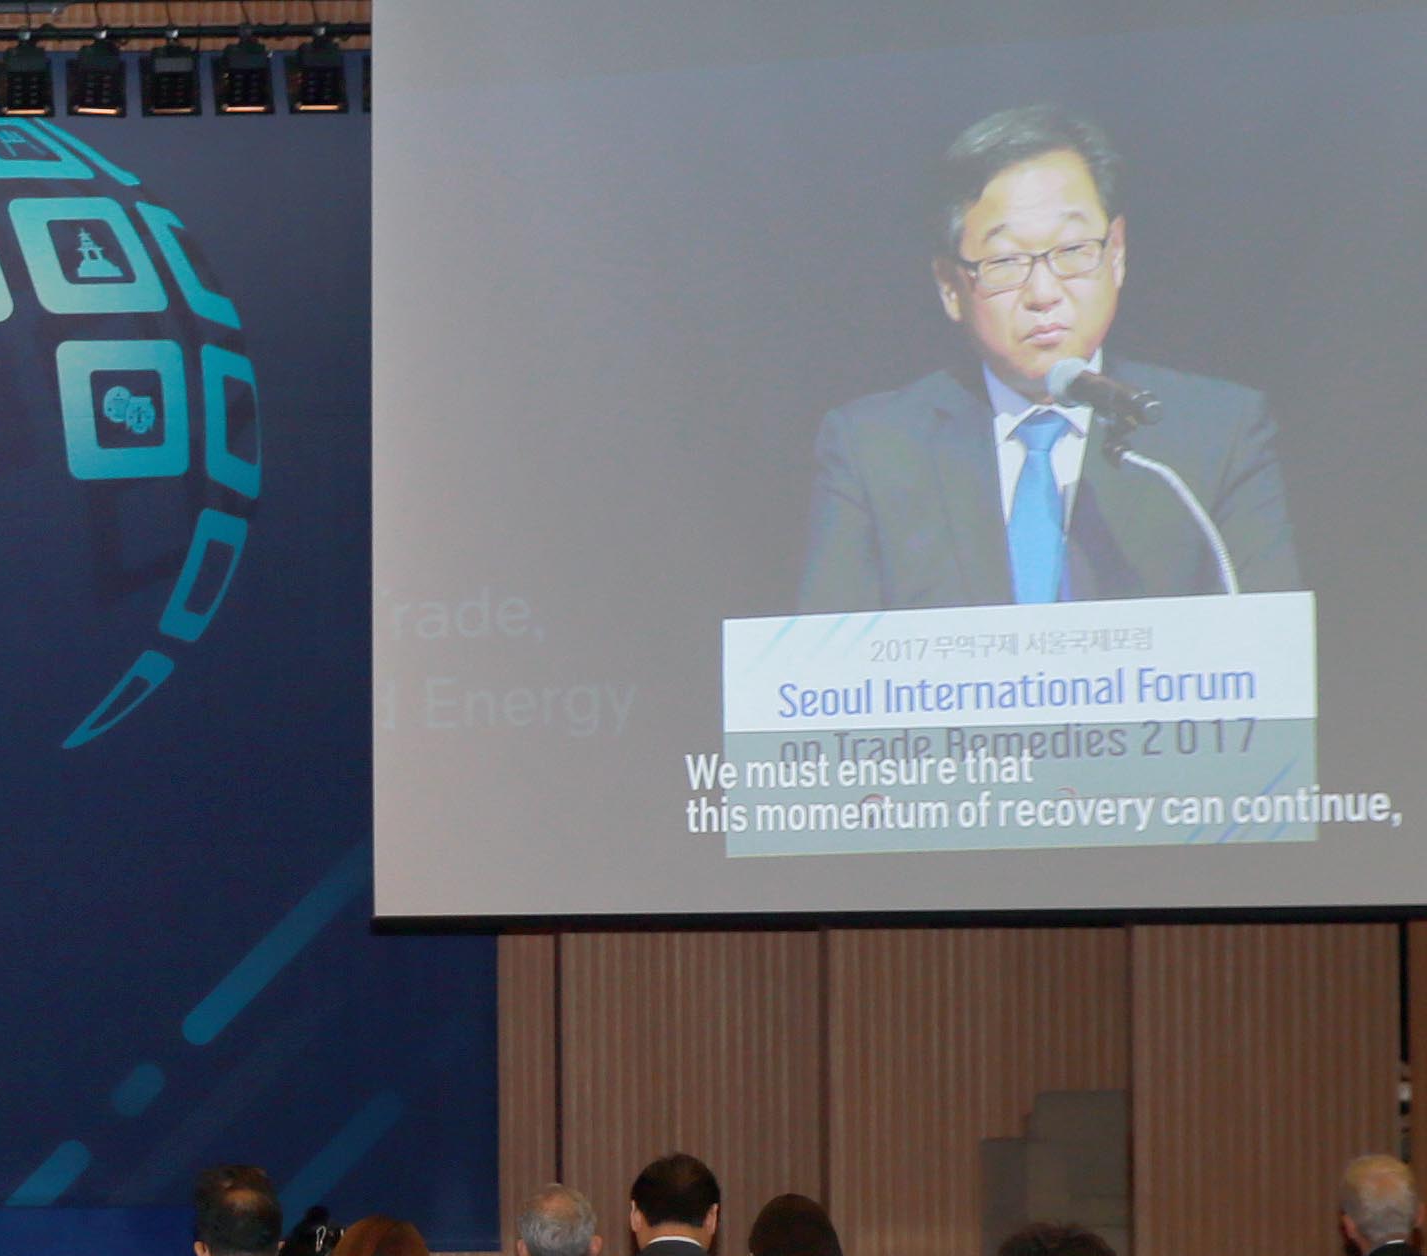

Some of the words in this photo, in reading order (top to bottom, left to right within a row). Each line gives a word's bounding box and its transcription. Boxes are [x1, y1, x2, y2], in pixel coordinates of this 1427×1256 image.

[778, 679, 873, 718] Seoul
[885, 668, 1123, 714] International
[1139, 667, 1257, 703] Forum
[947, 724, 1127, 763] Remedies
[685, 753, 739, 791] We
[747, 753, 830, 789] must
[837, 754, 957, 787] ensure
[965, 747, 1034, 786] that
[687, 795, 748, 833] this
[756, 797, 948, 832] momentum
[958, 790, 993, 829] of
[999, 797, 1156, 832] recovery
[1162, 796, 1225, 827] can
[1233, 784, 1403, 827] continue,
